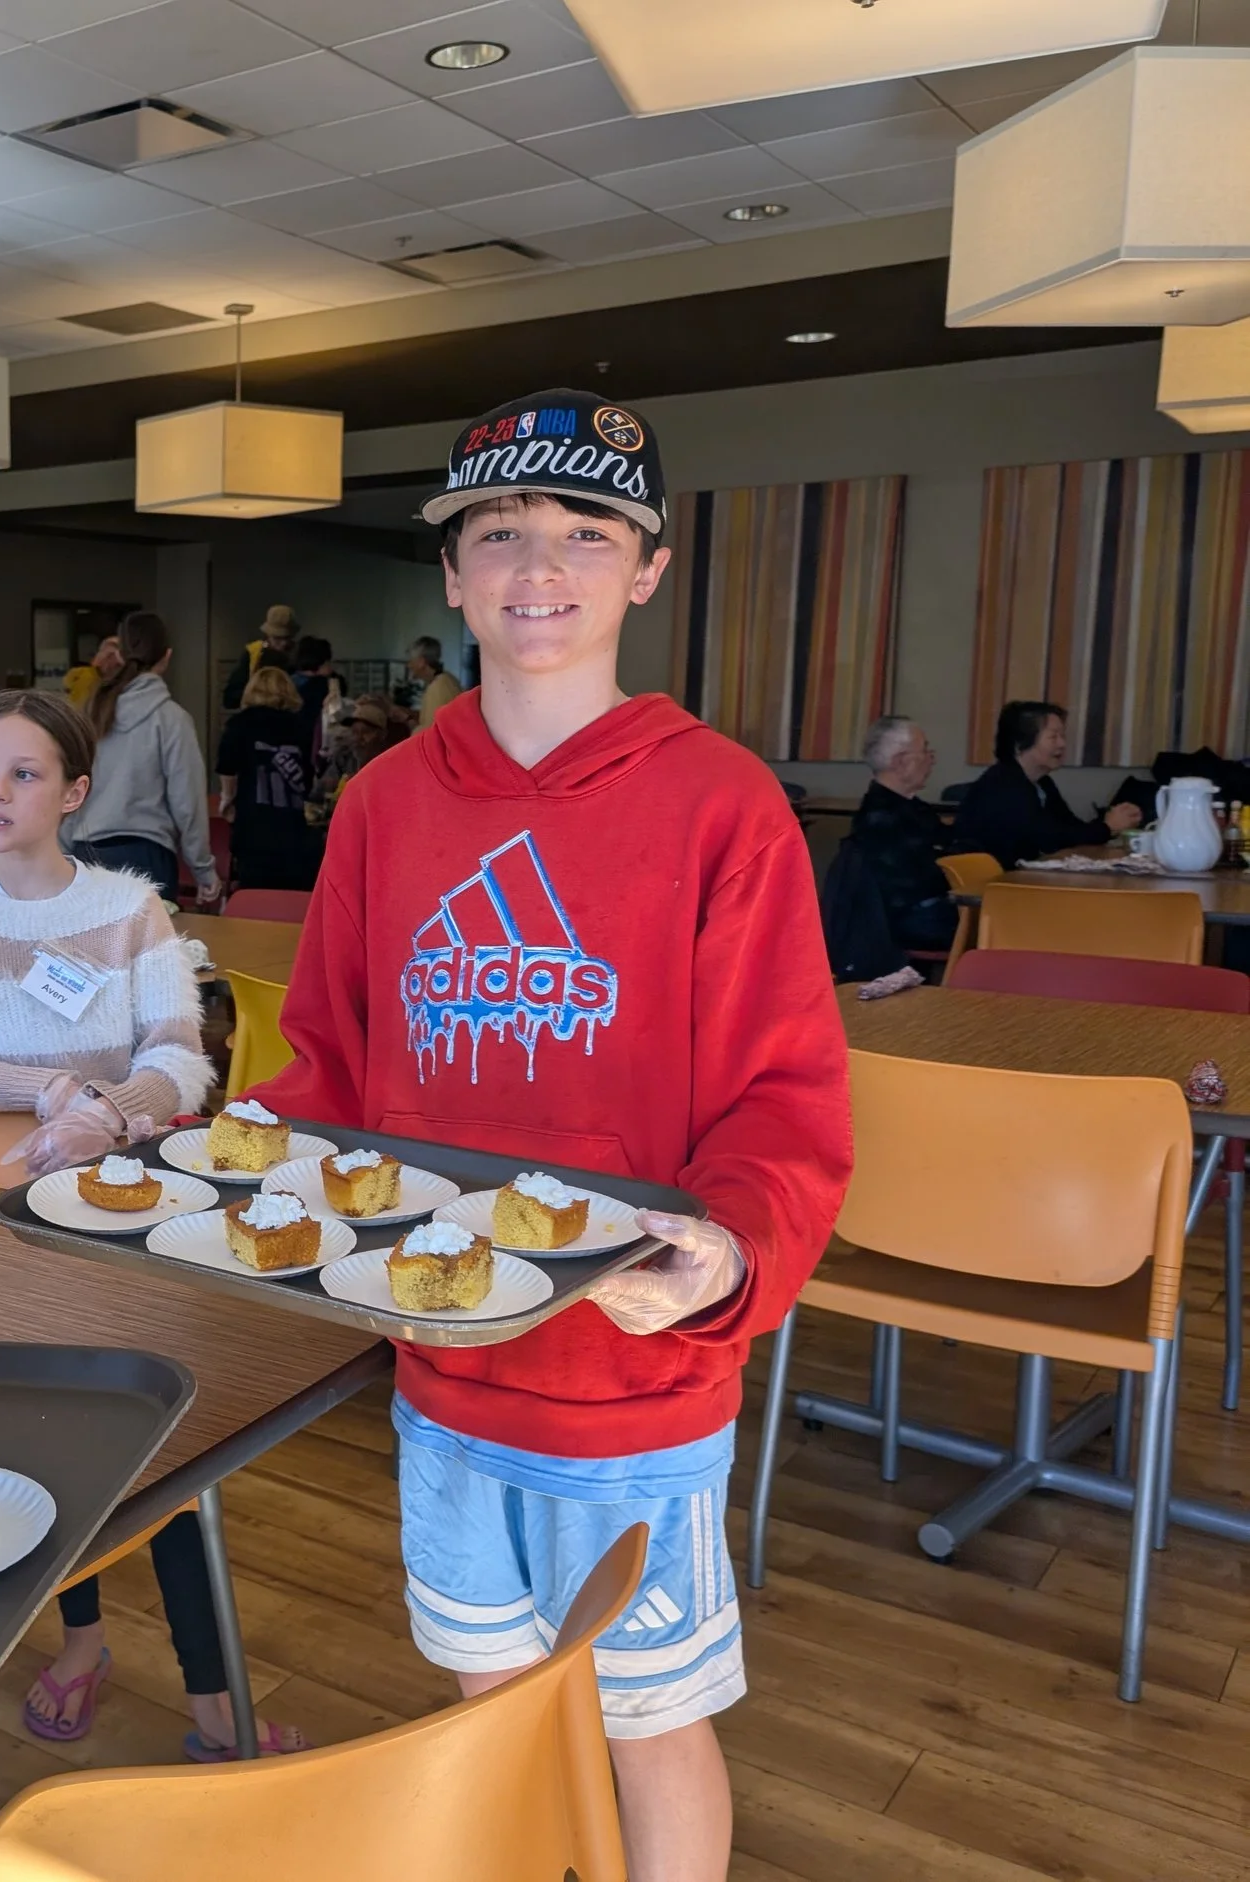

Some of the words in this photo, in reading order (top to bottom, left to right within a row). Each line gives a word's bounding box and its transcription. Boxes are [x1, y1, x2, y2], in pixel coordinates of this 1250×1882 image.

[464, 415, 518, 453] 22-23
[536, 408, 576, 437] NBA
[447, 438, 648, 500] ampions
[41, 983, 68, 1003] Avery
[404, 946, 612, 1010] adidas
